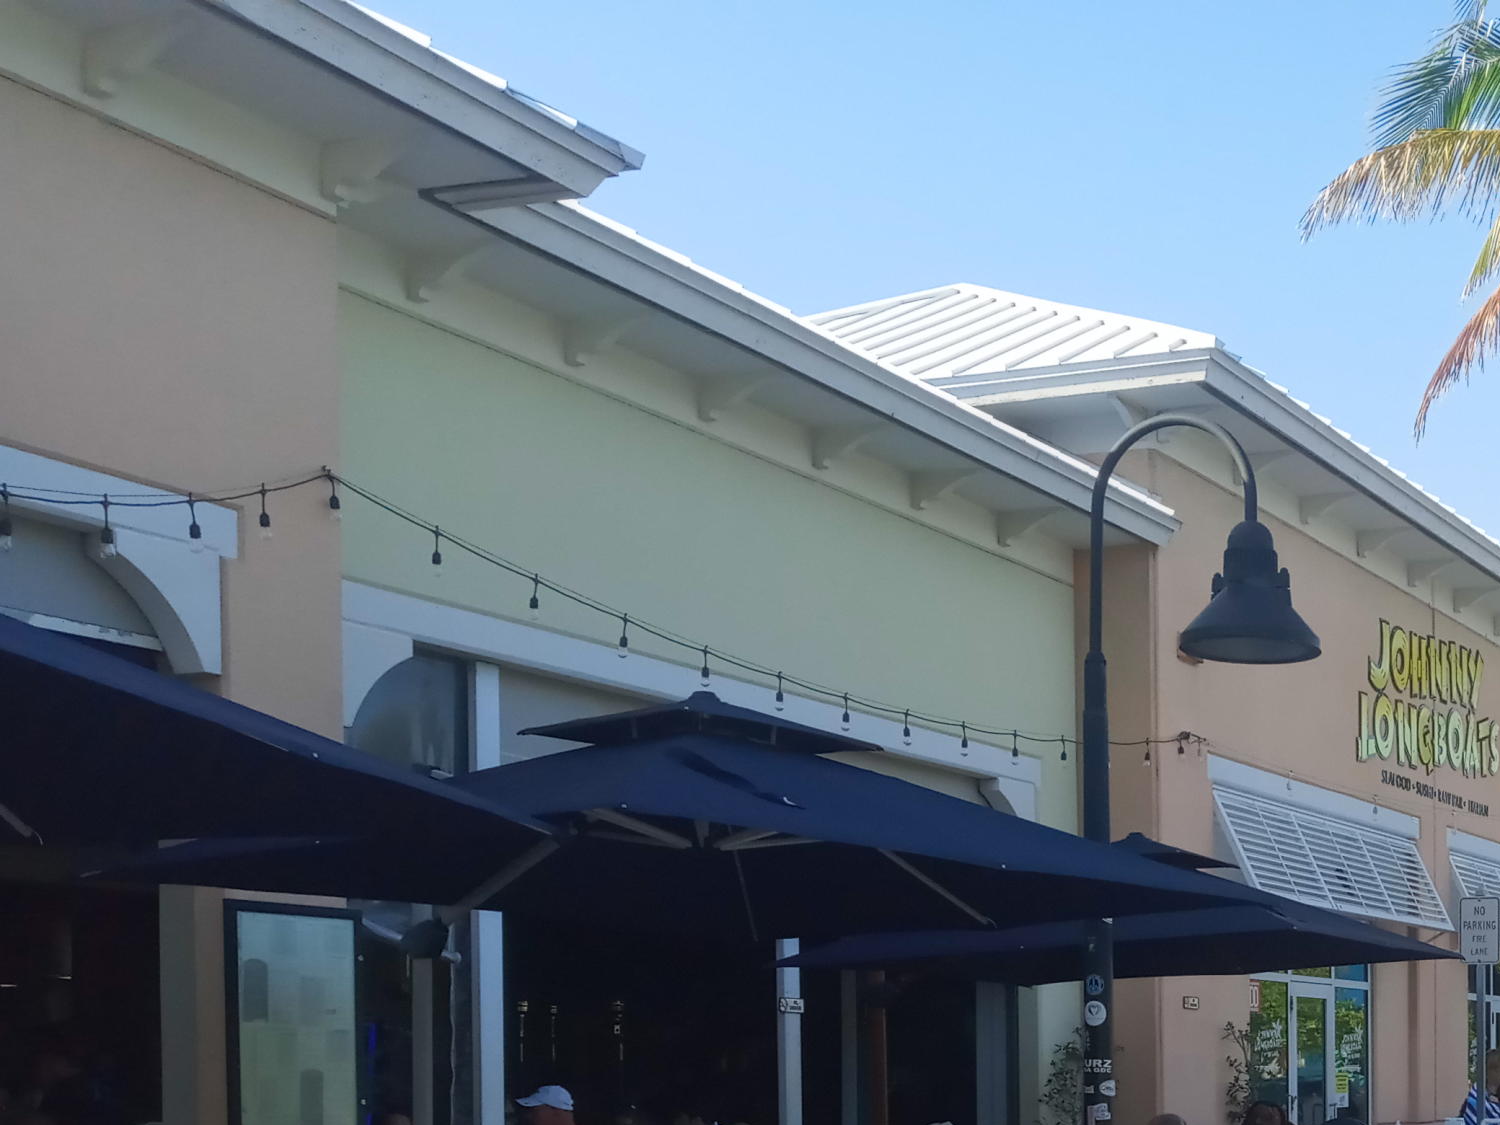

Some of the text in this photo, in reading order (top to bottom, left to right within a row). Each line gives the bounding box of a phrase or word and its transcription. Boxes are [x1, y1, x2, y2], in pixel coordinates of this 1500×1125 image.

[1368, 617, 1484, 710] JOHNNY
[1356, 691, 1500, 779] LONGBOATS
[1473, 906, 1486, 916] NO
[1463, 921, 1496, 930] PARKING
[1470, 947, 1488, 956] LANE
